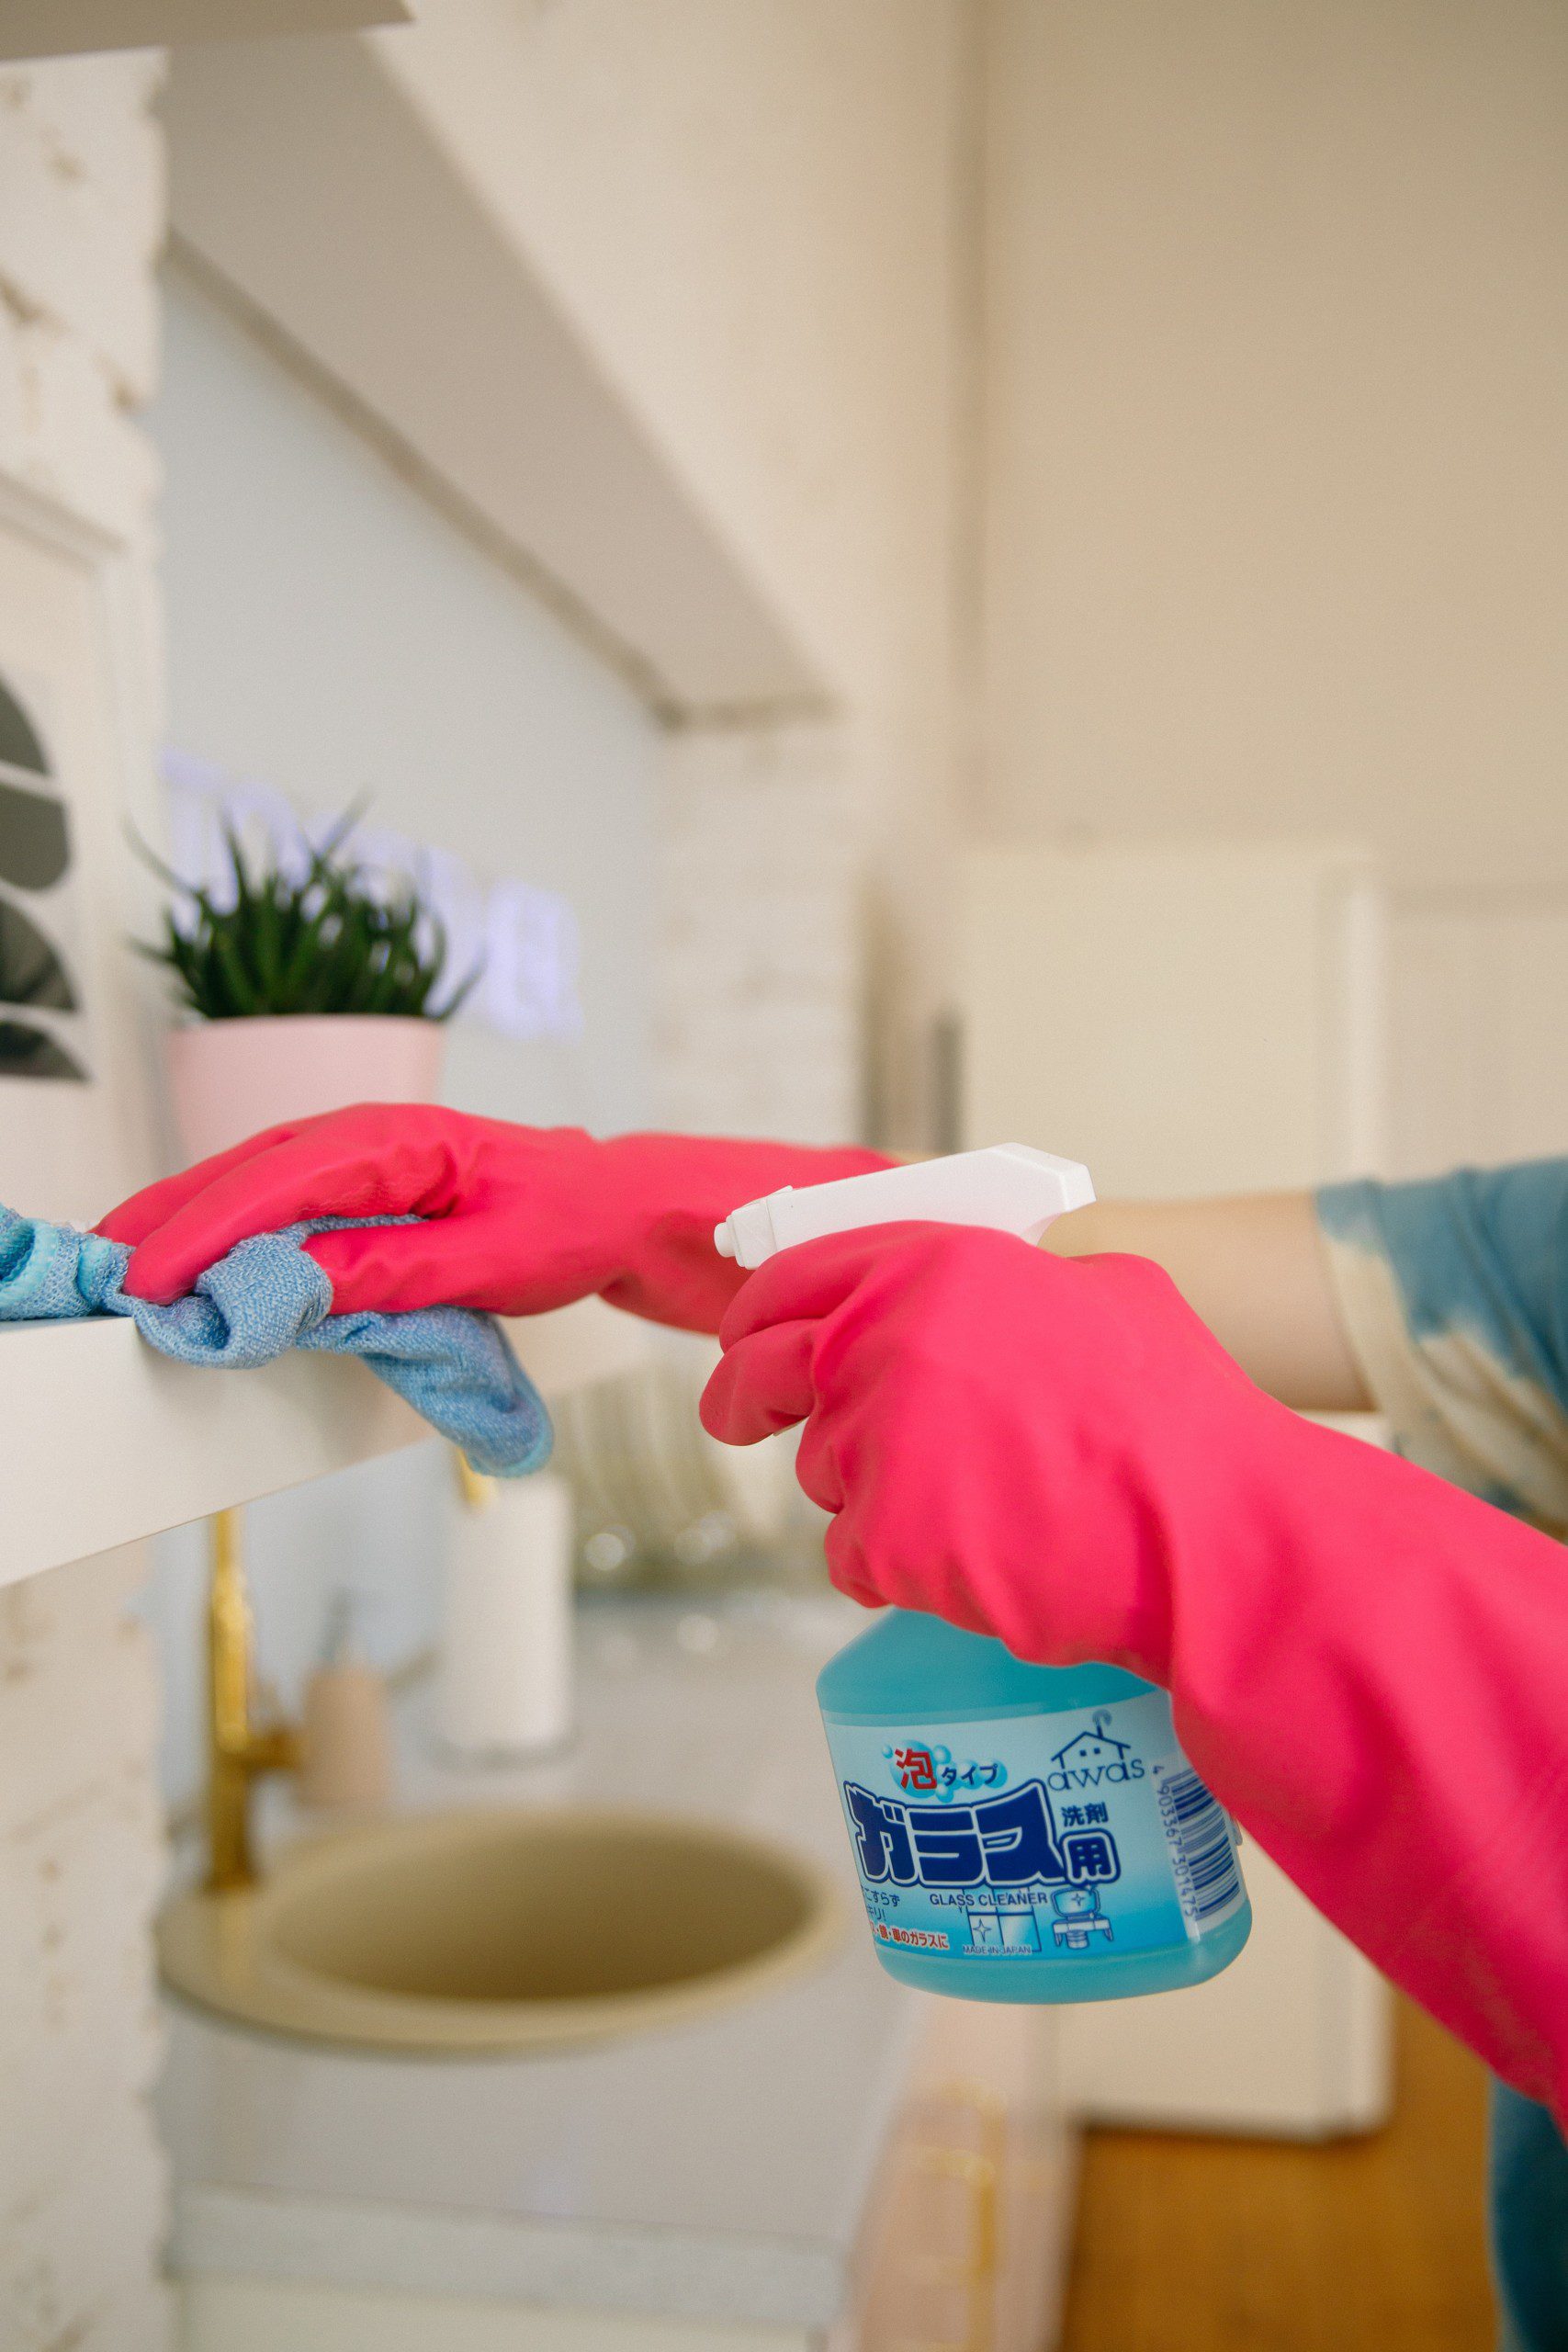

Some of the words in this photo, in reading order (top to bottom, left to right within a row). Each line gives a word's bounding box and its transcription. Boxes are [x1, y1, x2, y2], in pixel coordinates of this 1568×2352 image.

[895, 1747, 998, 1790] 泡タイプ
[1047, 1758, 1145, 1792] awas
[1061, 1802, 1109, 1827] 洗剤
[1157, 1786, 1182, 1847] 903367
[1172, 1854, 1199, 1917] 301475
[862, 1886, 900, 1907] こすらず
[930, 1893, 976, 1906] GLASS
[979, 1891, 1048, 1906] CLEANER
[963, 1945, 987, 1954] MADE
[989, 1945, 999, 1954] IN
[1002, 1945, 1032, 1954] JAPAN
